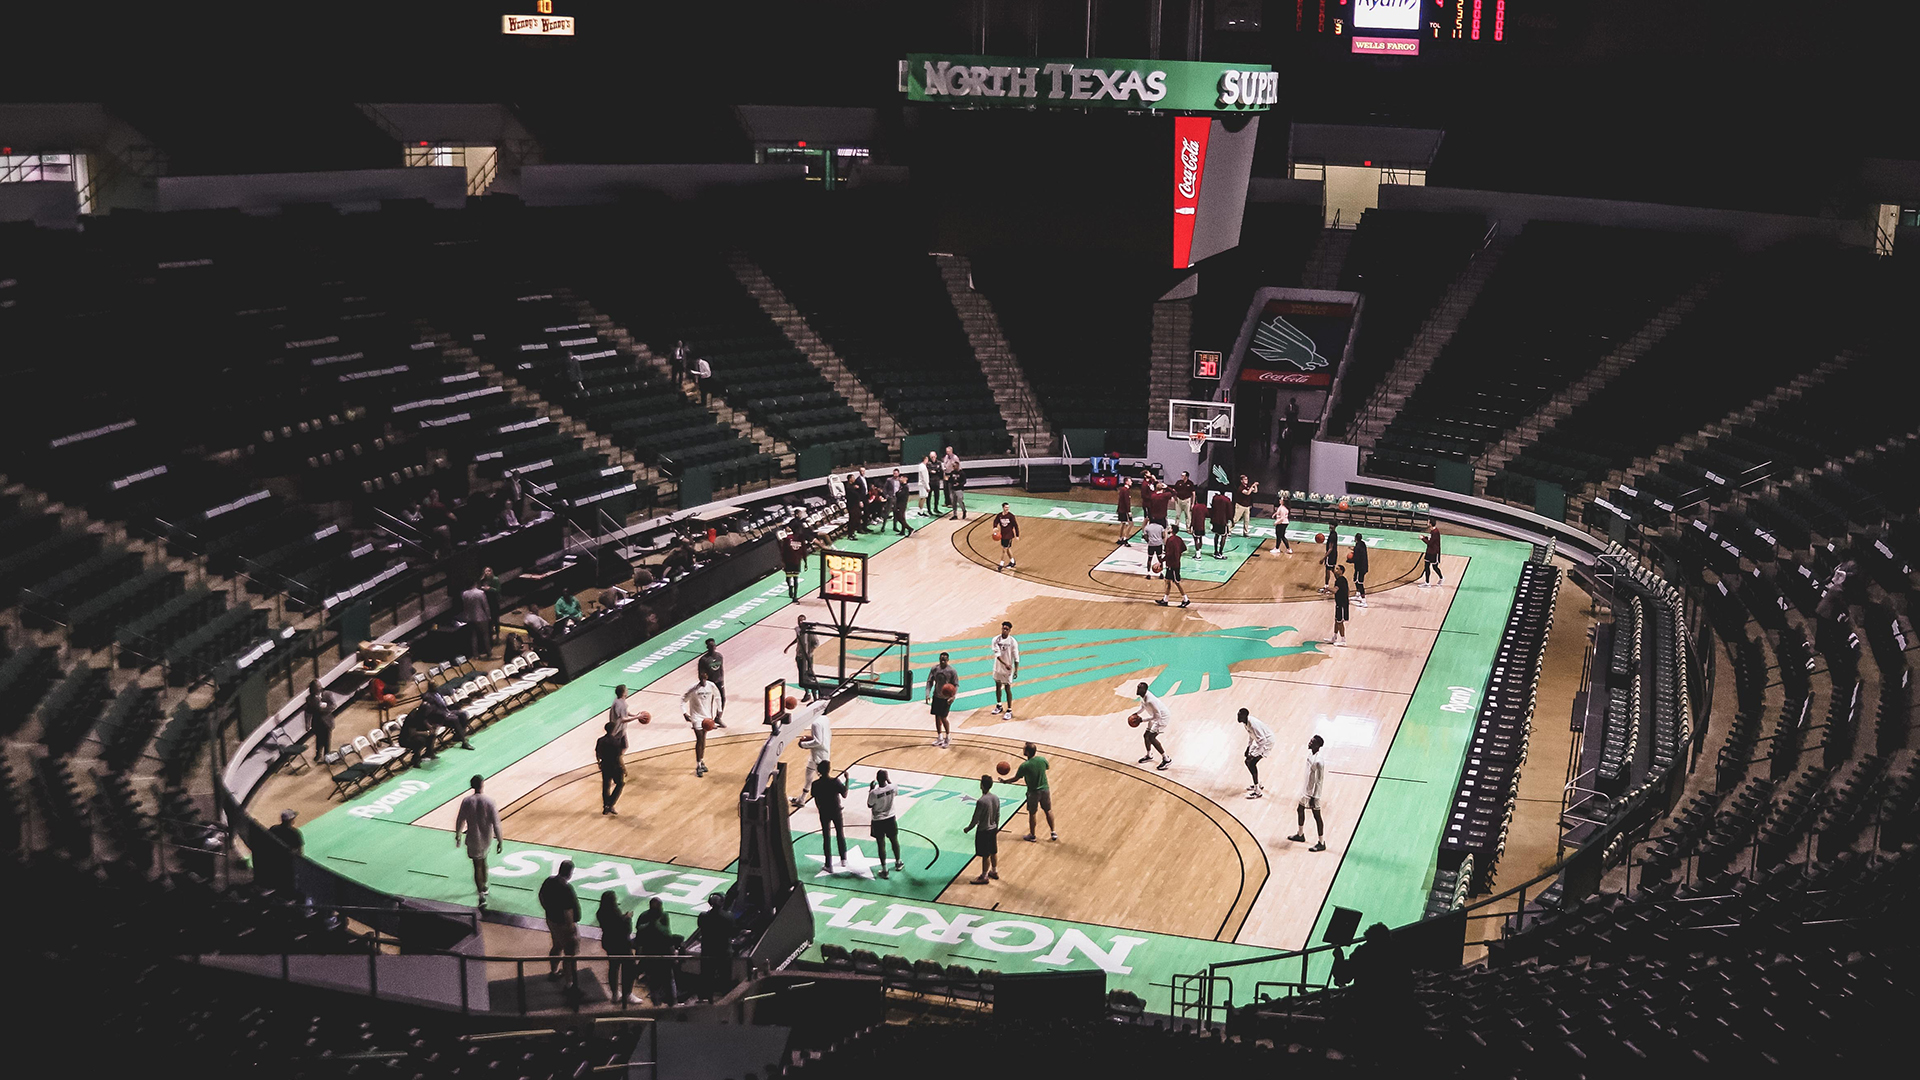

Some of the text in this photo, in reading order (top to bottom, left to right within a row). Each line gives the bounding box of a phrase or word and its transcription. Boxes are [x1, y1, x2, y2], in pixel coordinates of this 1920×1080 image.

[508, 17, 571, 32] Wendy's Wendy's
[1355, 41, 1416, 51] WELLS FARGO
[923, 60, 1040, 98] NORTH
[1043, 63, 1168, 101] TEXAS
[1200, 361, 1217, 376] 30
[623, 629, 709, 674] UNIVERSITY
[703, 618, 727, 631] OF
[720, 597, 769, 619] NORTH
[348, 780, 425, 819] Ryan
[804, 890, 1149, 975] NORTH
